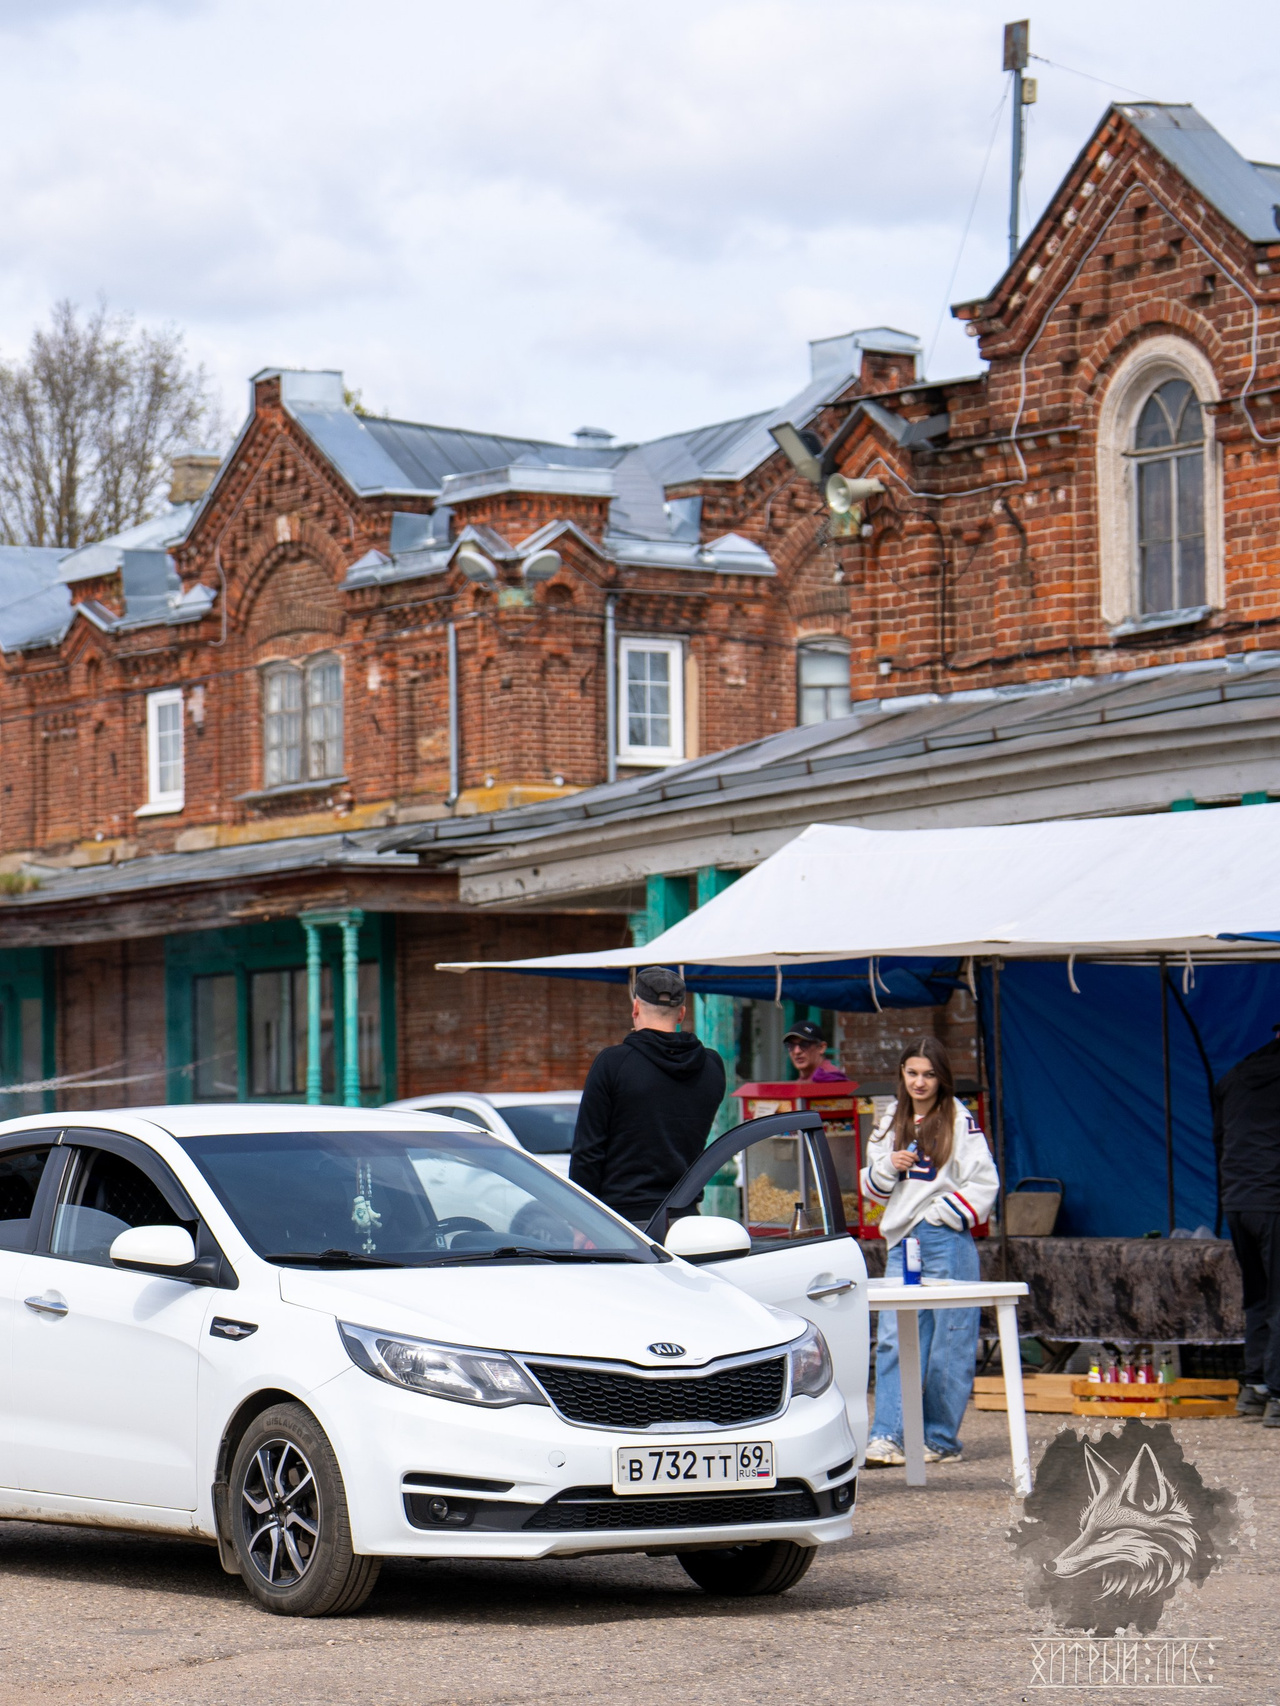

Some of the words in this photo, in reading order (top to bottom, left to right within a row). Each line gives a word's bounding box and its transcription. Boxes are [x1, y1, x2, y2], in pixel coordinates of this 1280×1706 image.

[652, 1343, 684, 1354] KIA
[740, 1445, 764, 1468] 69
[739, 1469, 757, 1478] RUS
